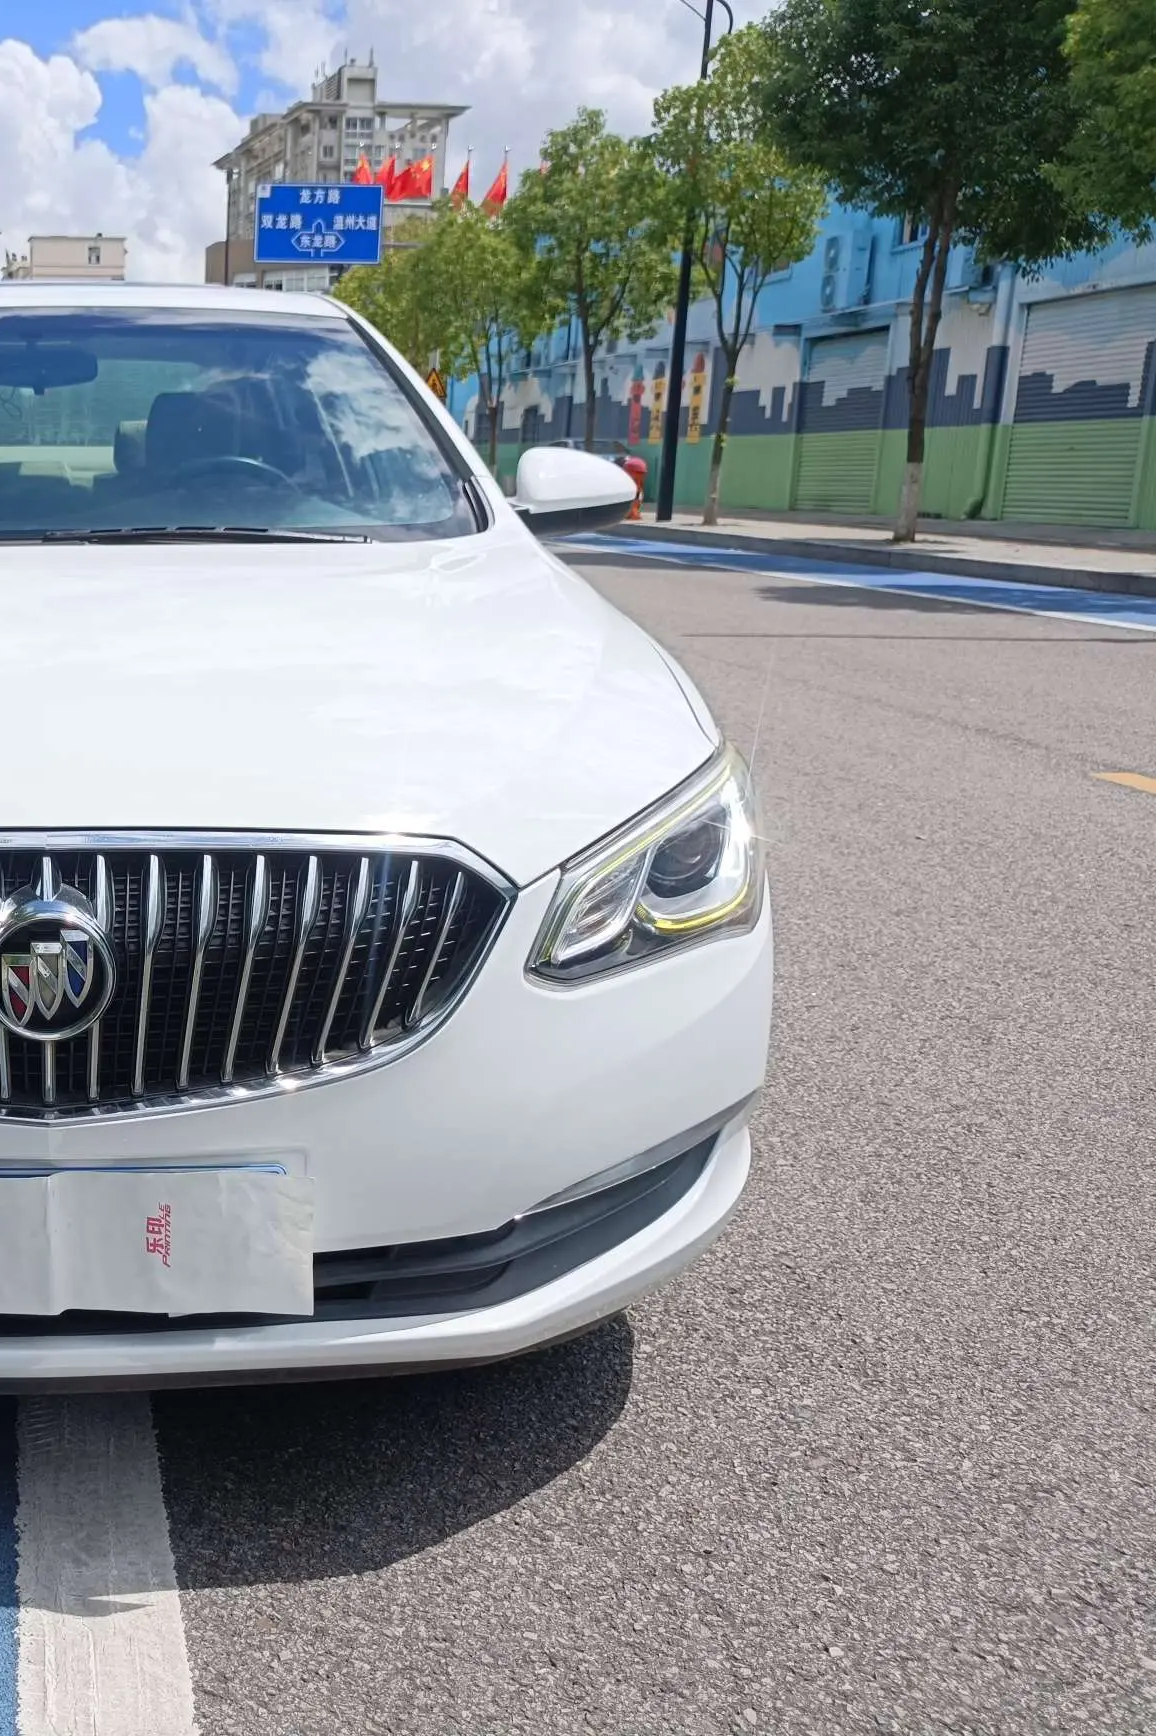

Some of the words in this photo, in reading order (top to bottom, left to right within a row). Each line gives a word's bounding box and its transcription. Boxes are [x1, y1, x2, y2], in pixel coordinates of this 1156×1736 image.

[300, 188, 341, 204] 龙方路
[260, 213, 303, 230] 双龙路
[332, 214, 377, 231] 温州大道
[299, 234, 337, 248] 东龙路
[146, 1216, 164, 1254] 乐印
[163, 1204, 171, 1268] PRINTING
